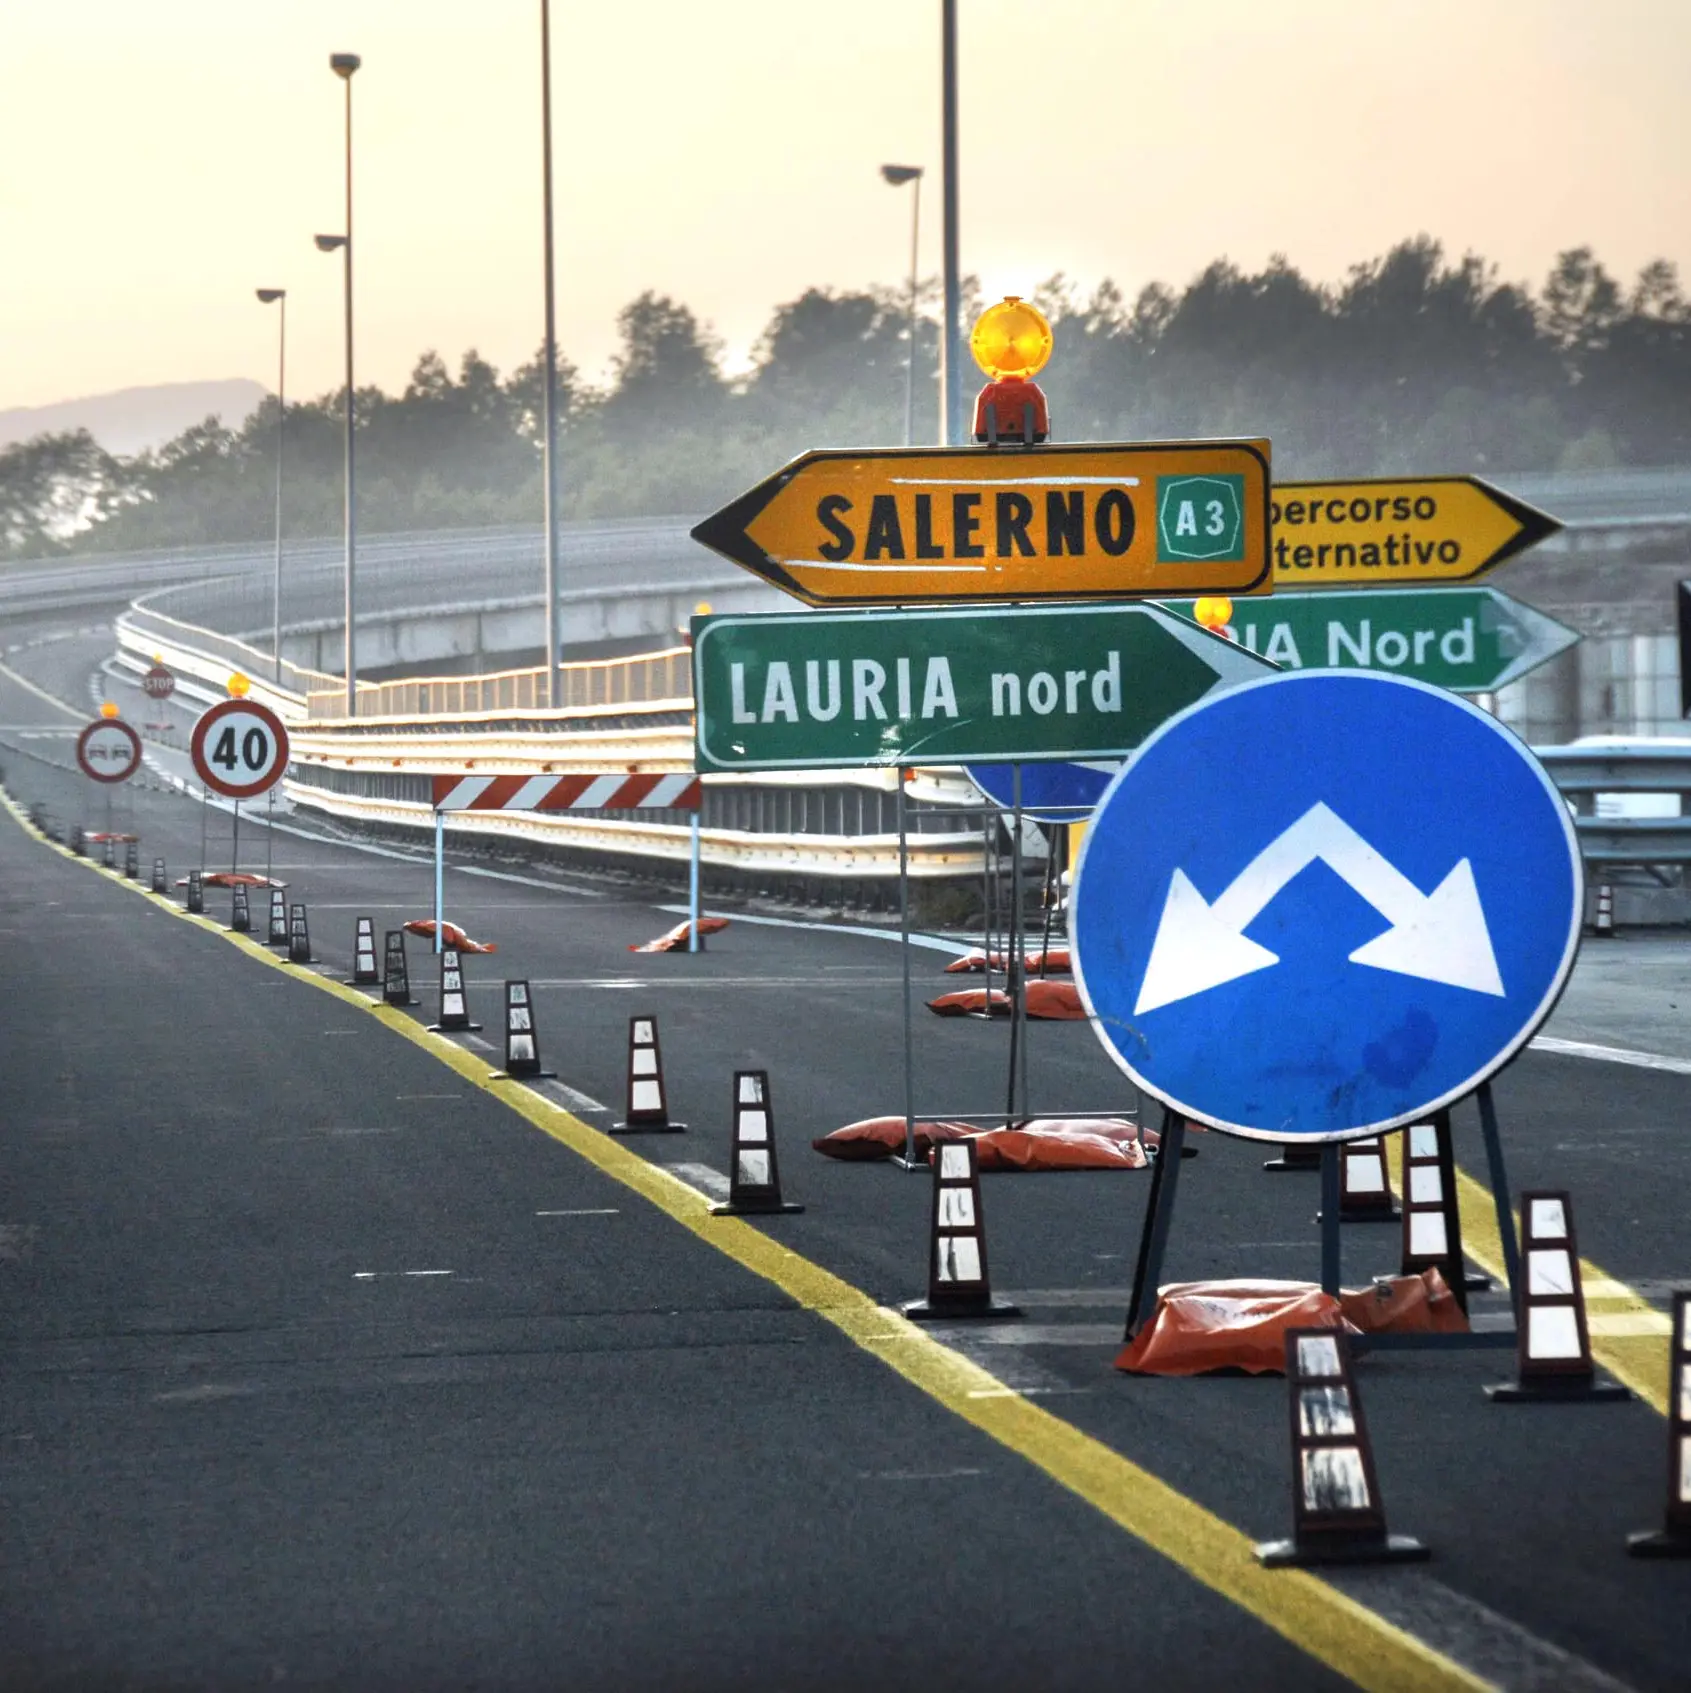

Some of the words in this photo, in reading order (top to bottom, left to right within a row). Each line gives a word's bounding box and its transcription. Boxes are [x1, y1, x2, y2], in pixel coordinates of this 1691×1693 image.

[816, 488, 1136, 562] SALERNO
[1327, 617, 1476, 667] Nord
[145, 677, 174, 691] STOP
[730, 656, 959, 724] LAURIA
[991, 650, 1122, 717] nord
[212, 726, 268, 771] 40
